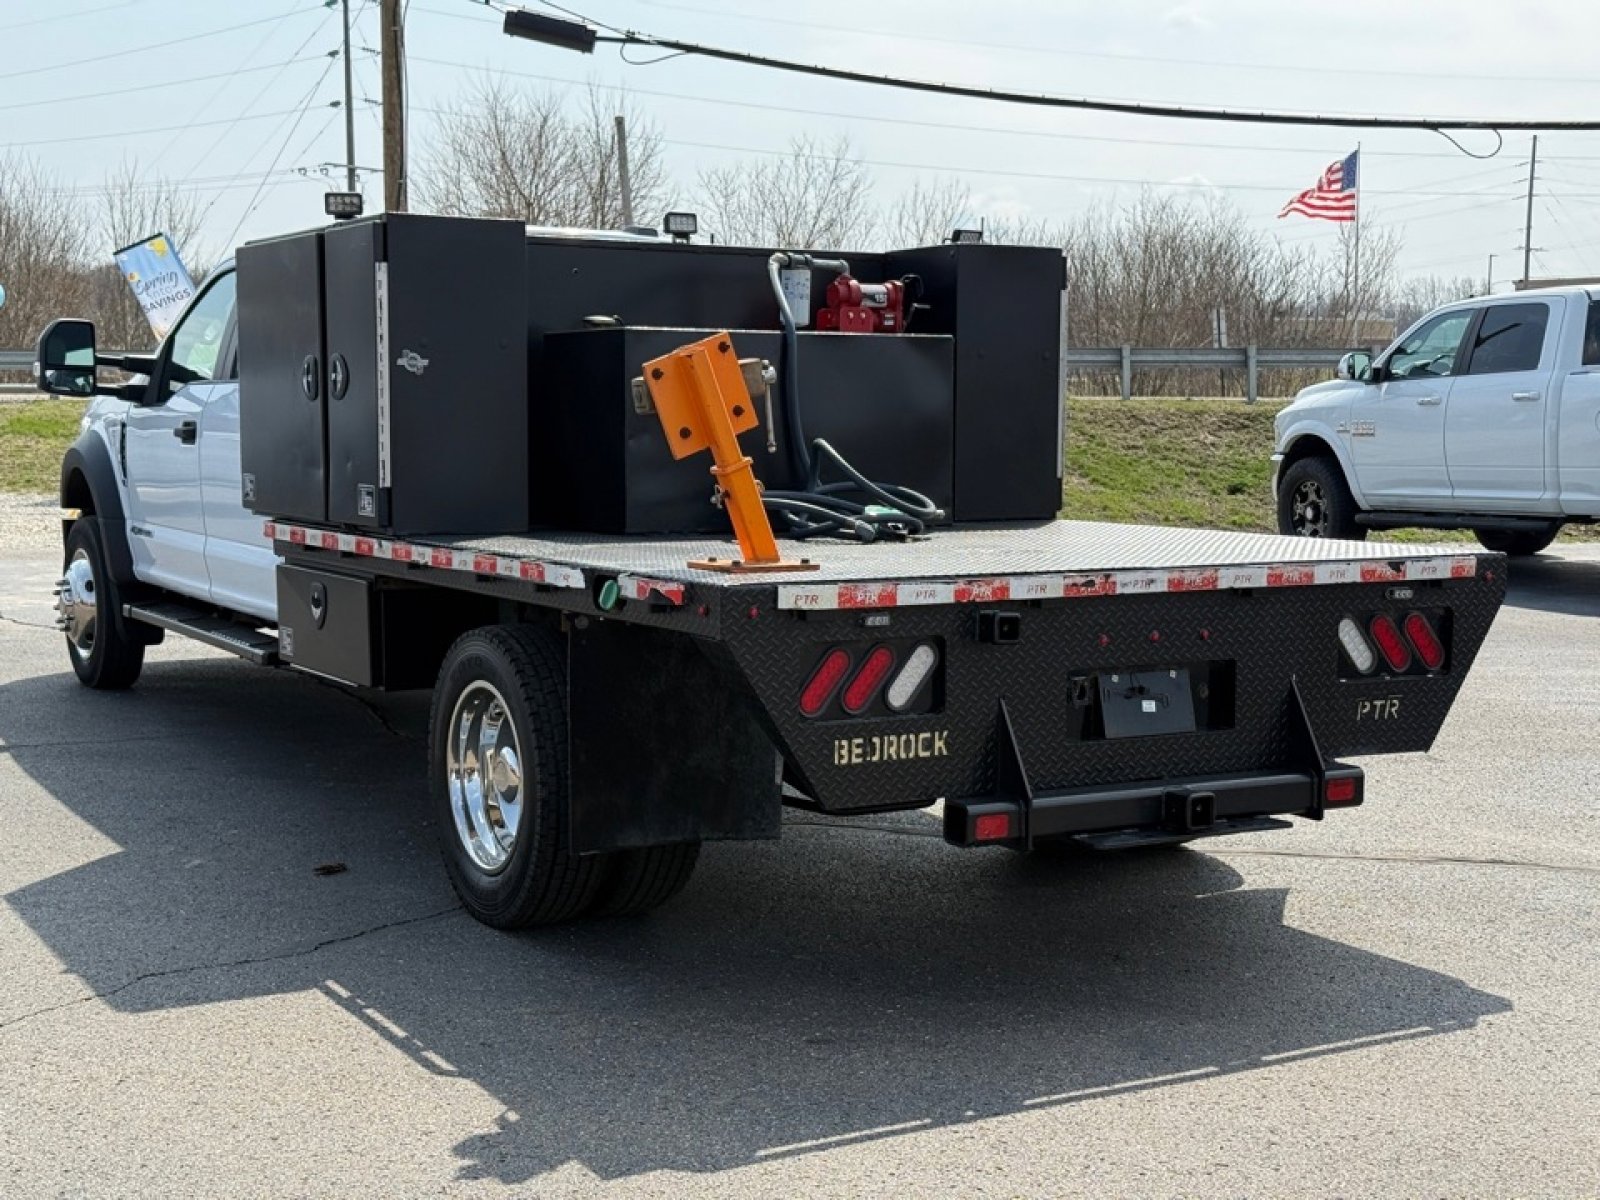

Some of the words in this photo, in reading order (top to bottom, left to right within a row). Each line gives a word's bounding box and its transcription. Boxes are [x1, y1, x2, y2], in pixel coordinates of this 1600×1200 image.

[137, 271, 179, 295] Spring
[143, 288, 191, 313] SAVINGS
[794, 594, 819, 606] PTR
[914, 589, 936, 600] PTR
[1026, 584, 1048, 594] PTR
[1232, 574, 1253, 584] PTR
[1329, 569, 1346, 579] PTR
[1420, 565, 1438, 575] PTR
[1356, 699, 1399, 720] PTR
